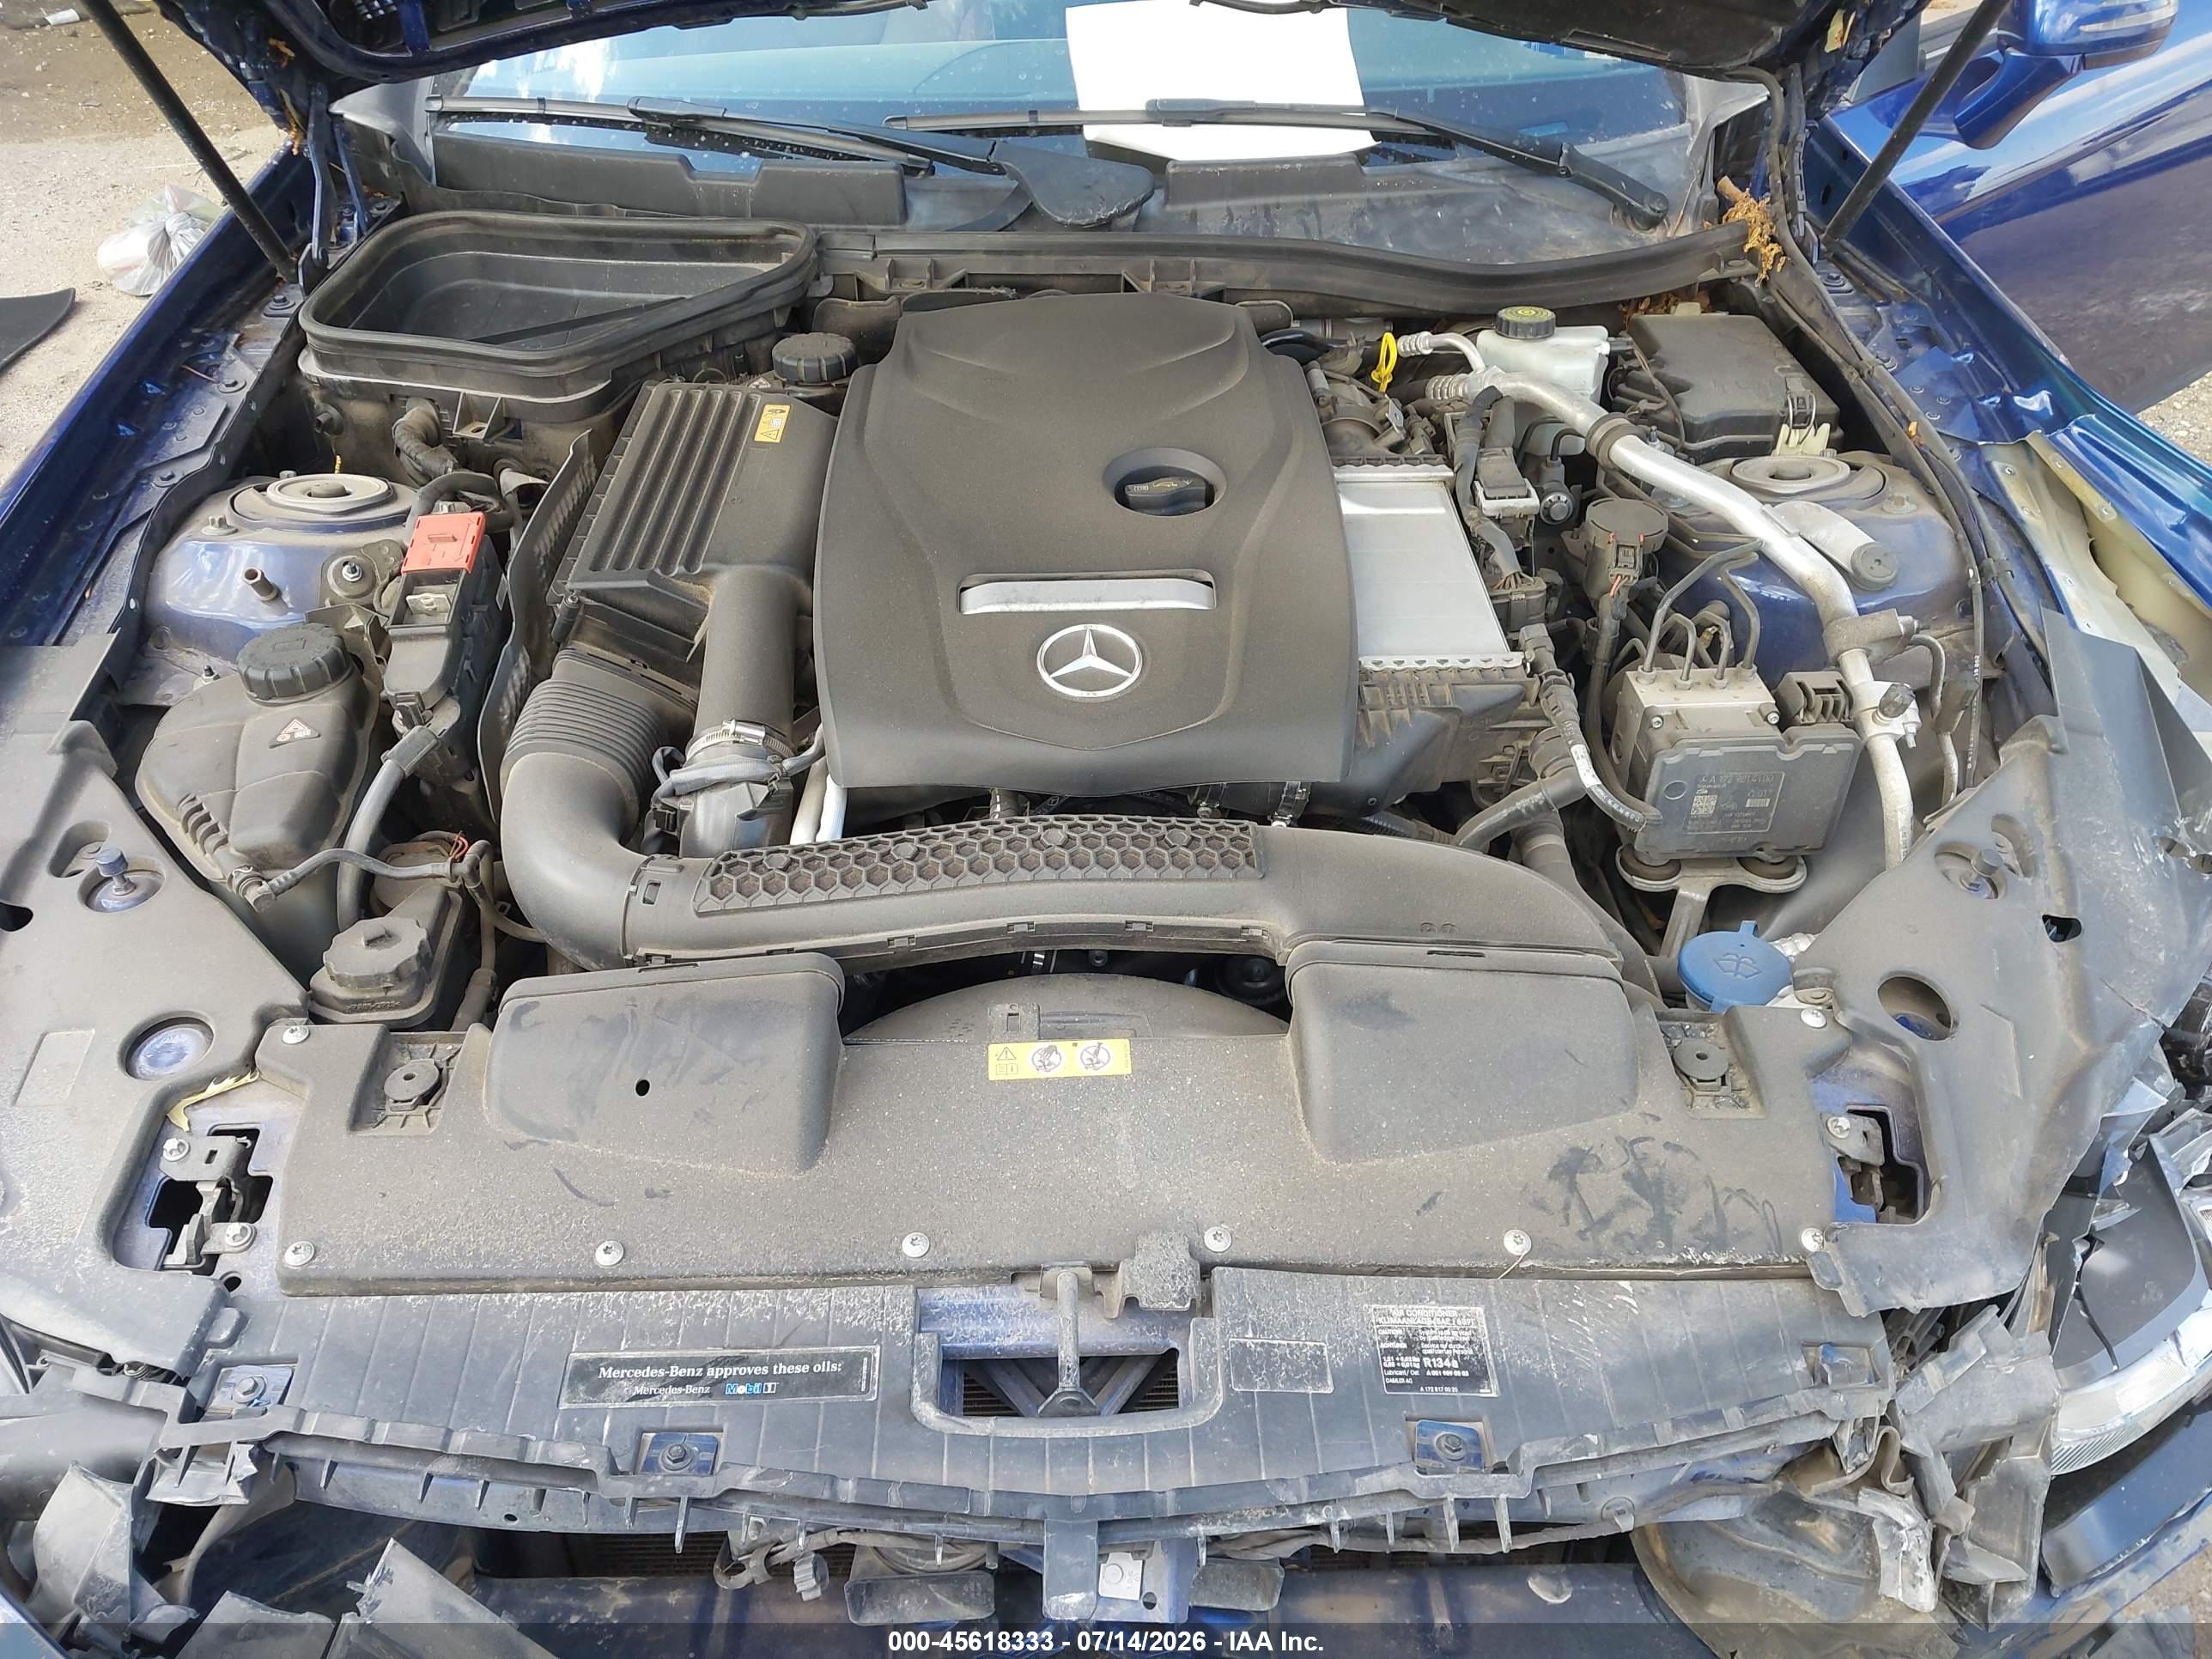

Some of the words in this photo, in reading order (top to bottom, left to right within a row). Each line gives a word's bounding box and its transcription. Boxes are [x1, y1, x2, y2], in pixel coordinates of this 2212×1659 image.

[1422, 1357, 1459, 1369] R134a
[598, 1365, 703, 1379] Mercedes-Benz
[707, 1363, 769, 1378] approves
[773, 1362, 810, 1375] these
[812, 1361, 842, 1374] oils:
[633, 1384, 711, 1395] Mercedes-Benz
[725, 1383, 763, 1395] Mobil
